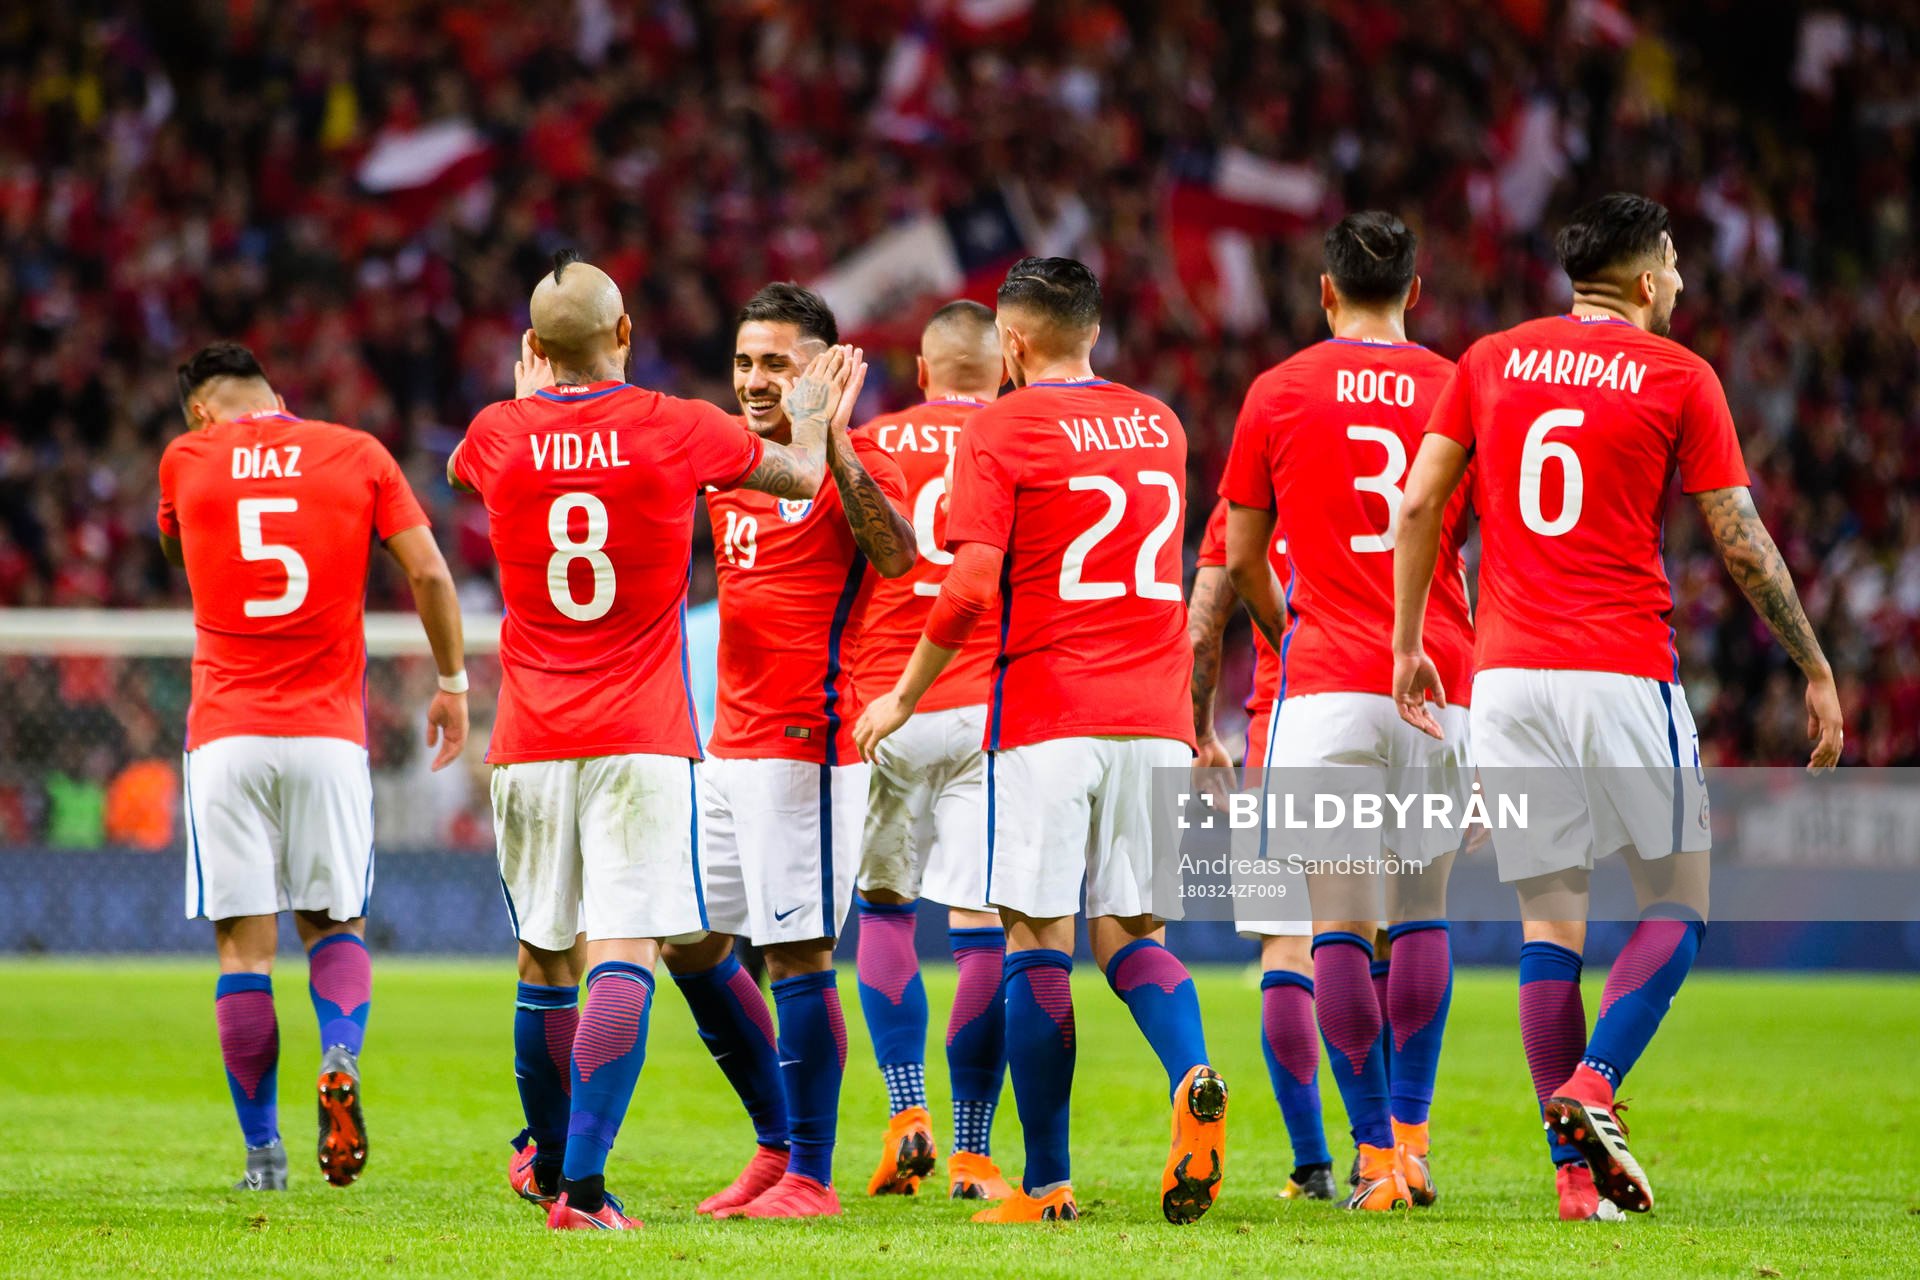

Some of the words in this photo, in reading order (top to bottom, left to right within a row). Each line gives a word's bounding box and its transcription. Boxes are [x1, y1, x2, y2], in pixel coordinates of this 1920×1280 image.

[1336, 369, 1417, 408] ROCO
[1503, 348, 1647, 395] MARIPÁN
[530, 430, 631, 472] VIDAL
[1058, 406, 1170, 454] VALDÉS
[231, 443, 303, 480] DÍAZ
[1346, 425, 1408, 554] 3
[1517, 407, 1586, 538] 6
[236, 497, 310, 618] 5
[546, 492, 618, 622] 8
[724, 510, 759, 570] 19
[1057, 470, 1184, 603] 22
